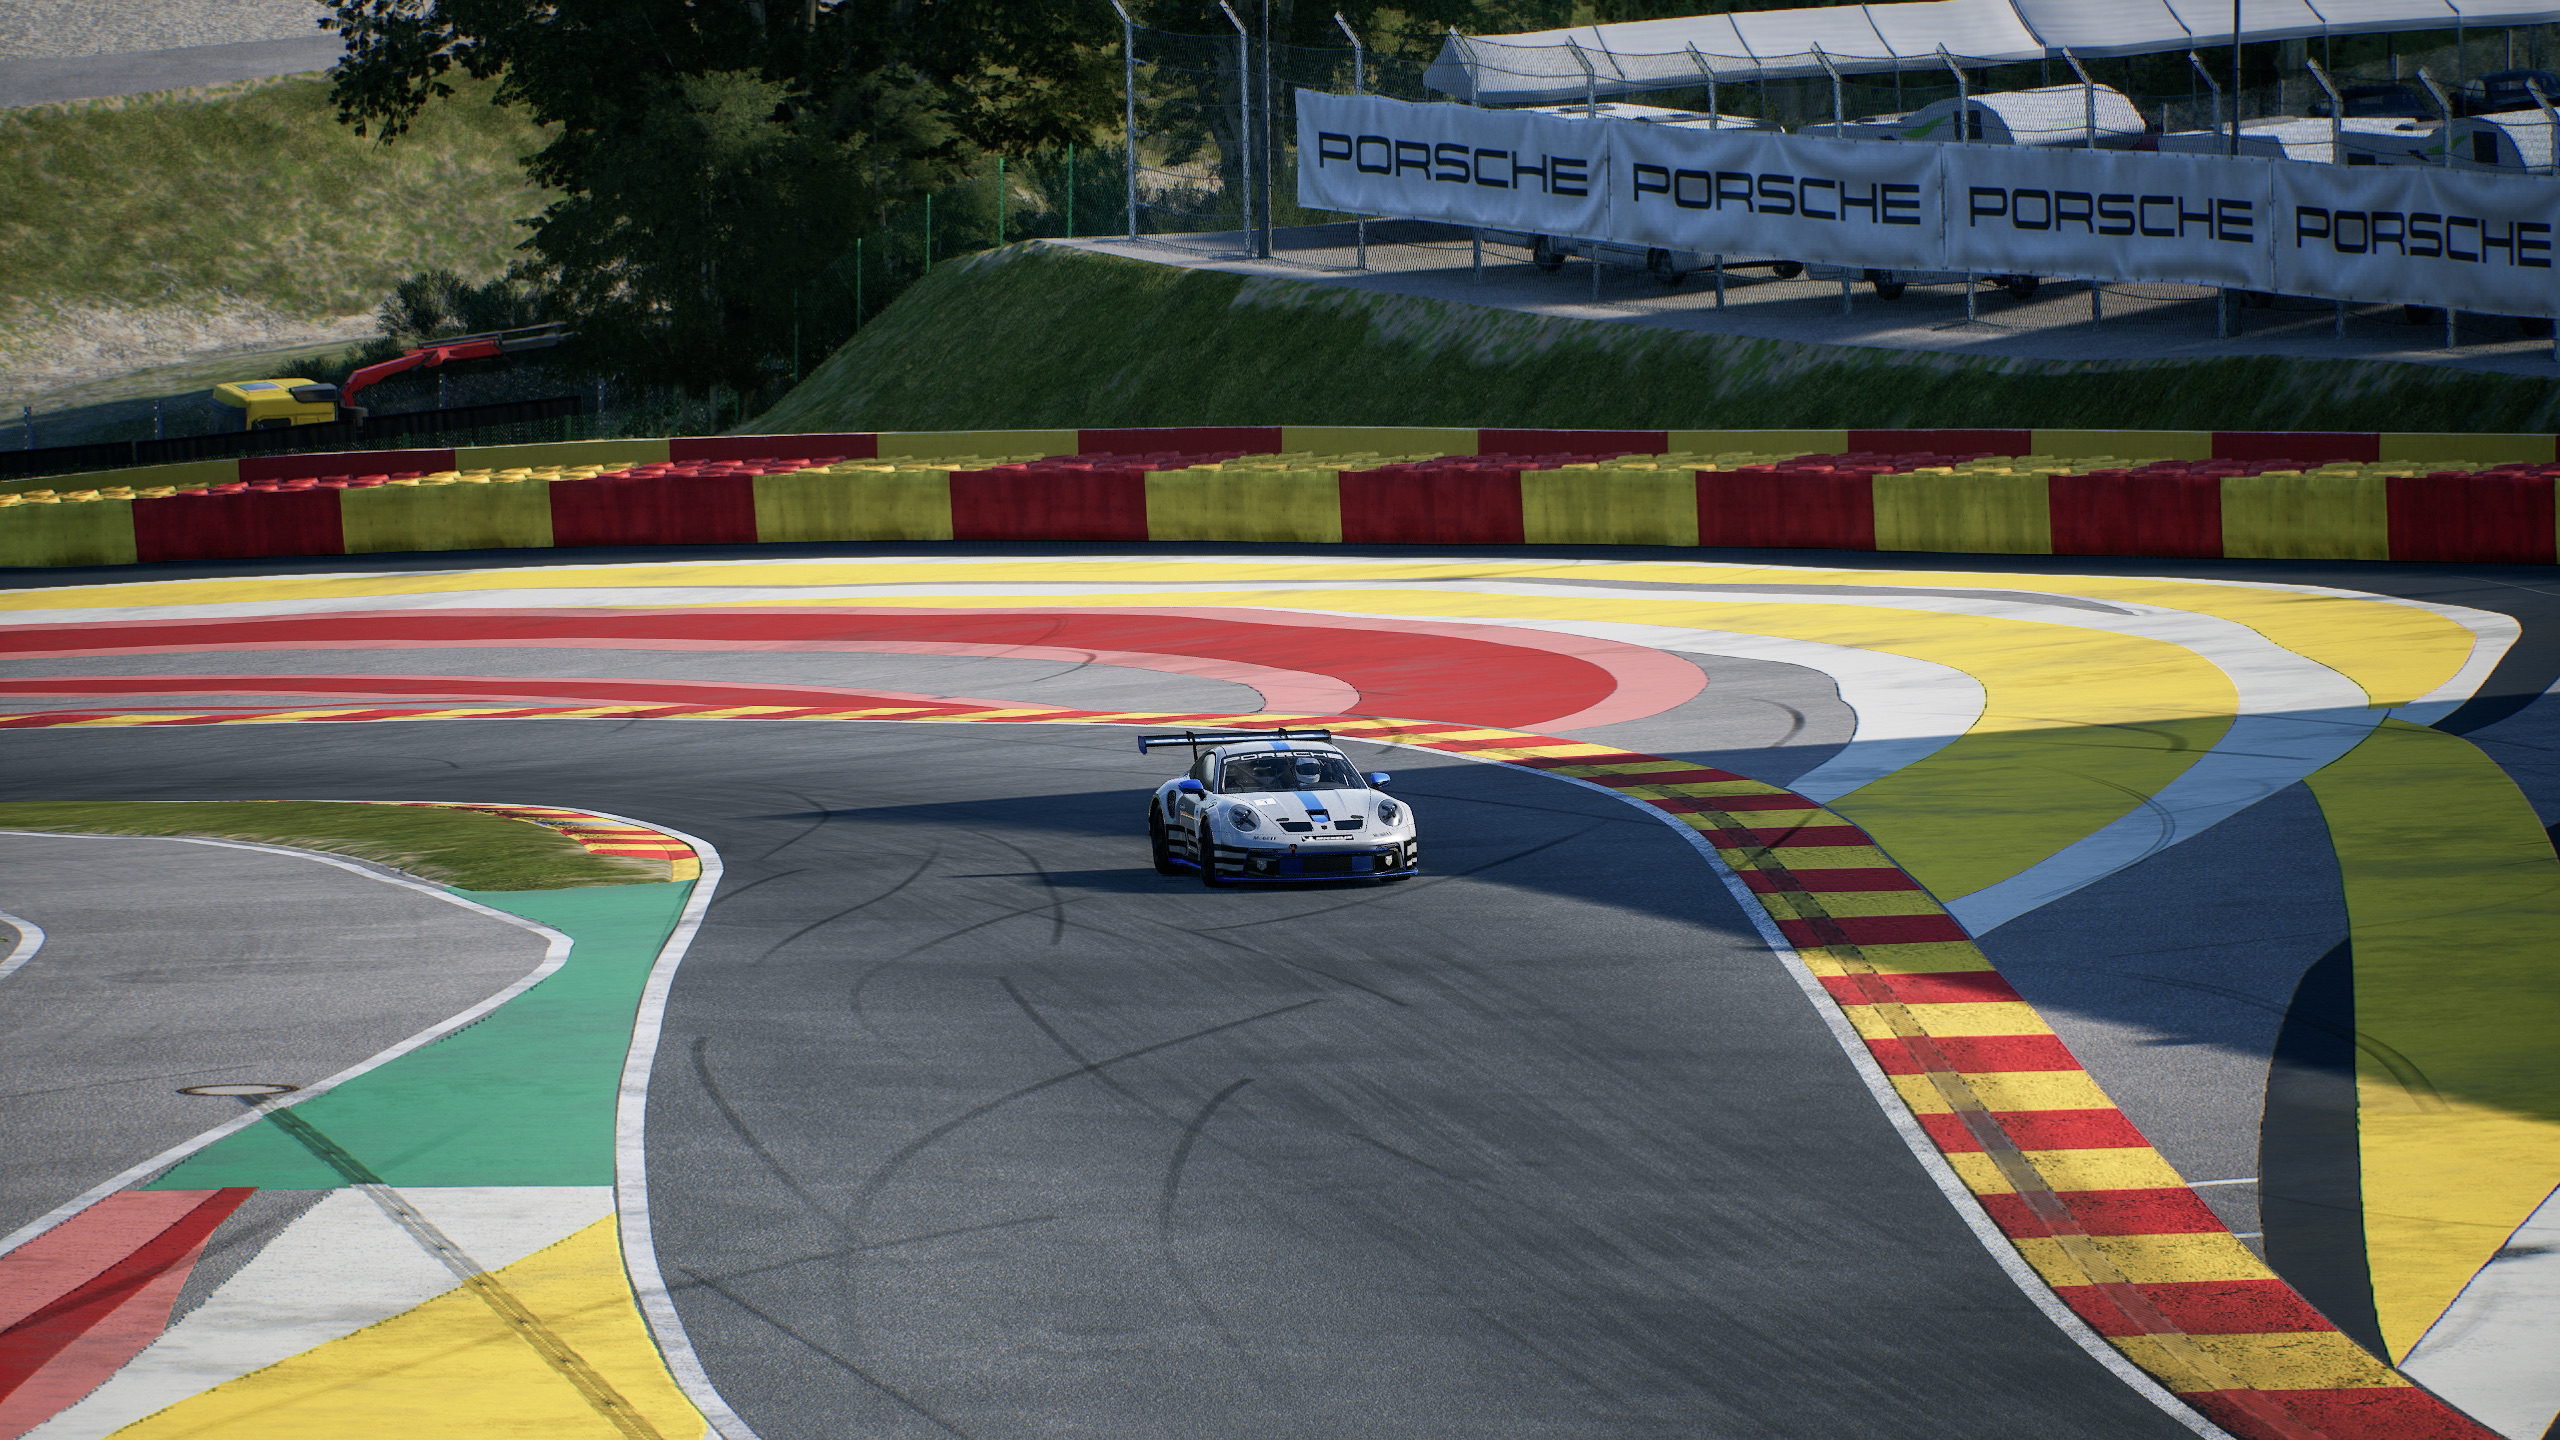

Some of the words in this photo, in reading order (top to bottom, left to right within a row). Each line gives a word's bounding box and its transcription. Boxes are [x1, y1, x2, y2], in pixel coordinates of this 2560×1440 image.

[1318, 131, 1588, 197] PORSCHE
[1633, 162, 1921, 225] PORSCHE
[1968, 186, 2254, 244] PORSCHE
[2295, 205, 2553, 269] PORSCHE
